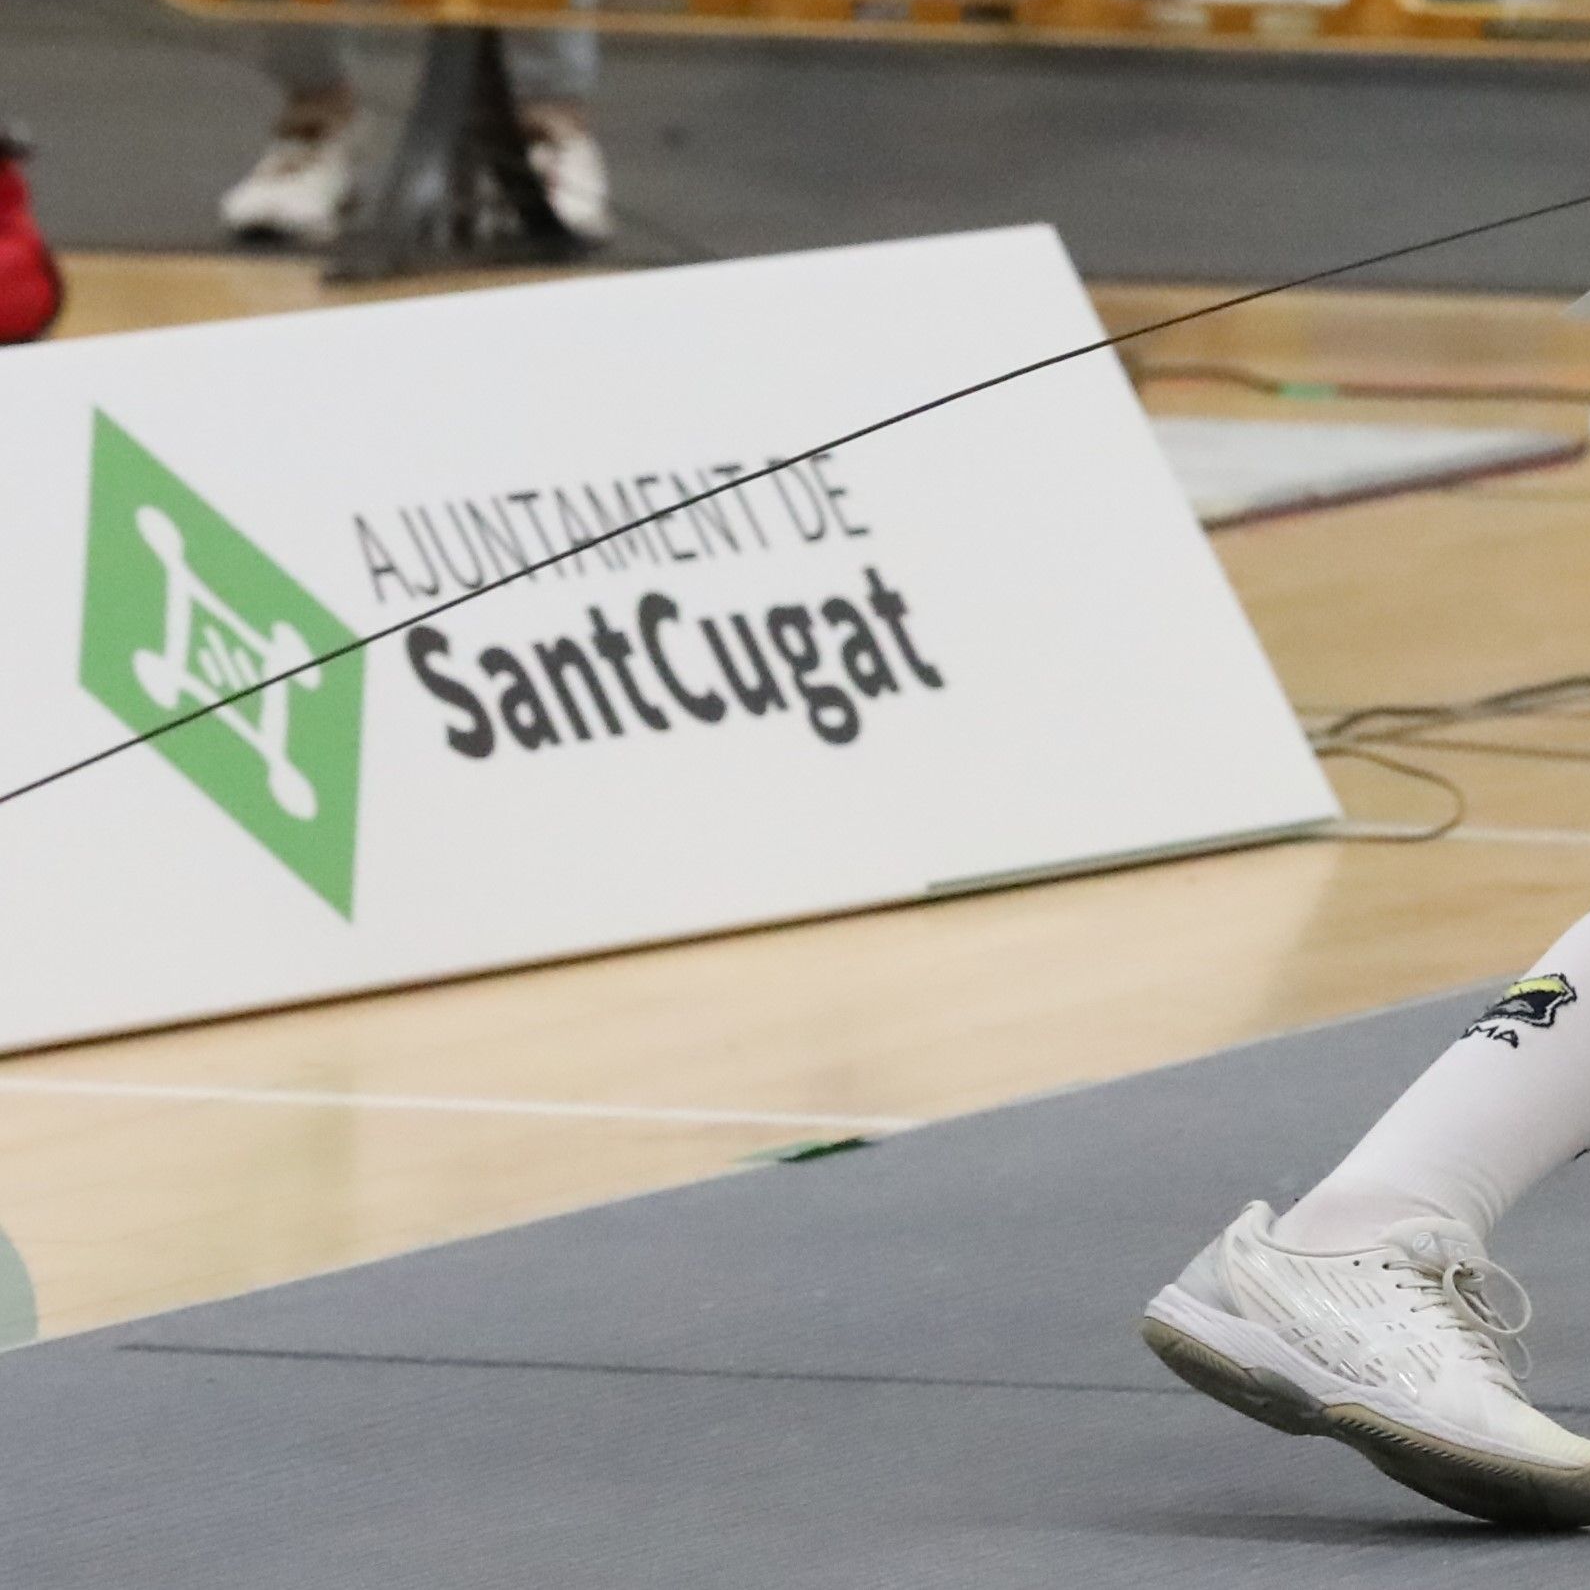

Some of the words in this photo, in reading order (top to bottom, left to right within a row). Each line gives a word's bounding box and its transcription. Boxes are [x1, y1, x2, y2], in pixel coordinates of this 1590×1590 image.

[354, 463, 769, 603] AJUNTAMENT
[766, 452, 870, 542] DE
[406, 565, 944, 759] SantCugat
